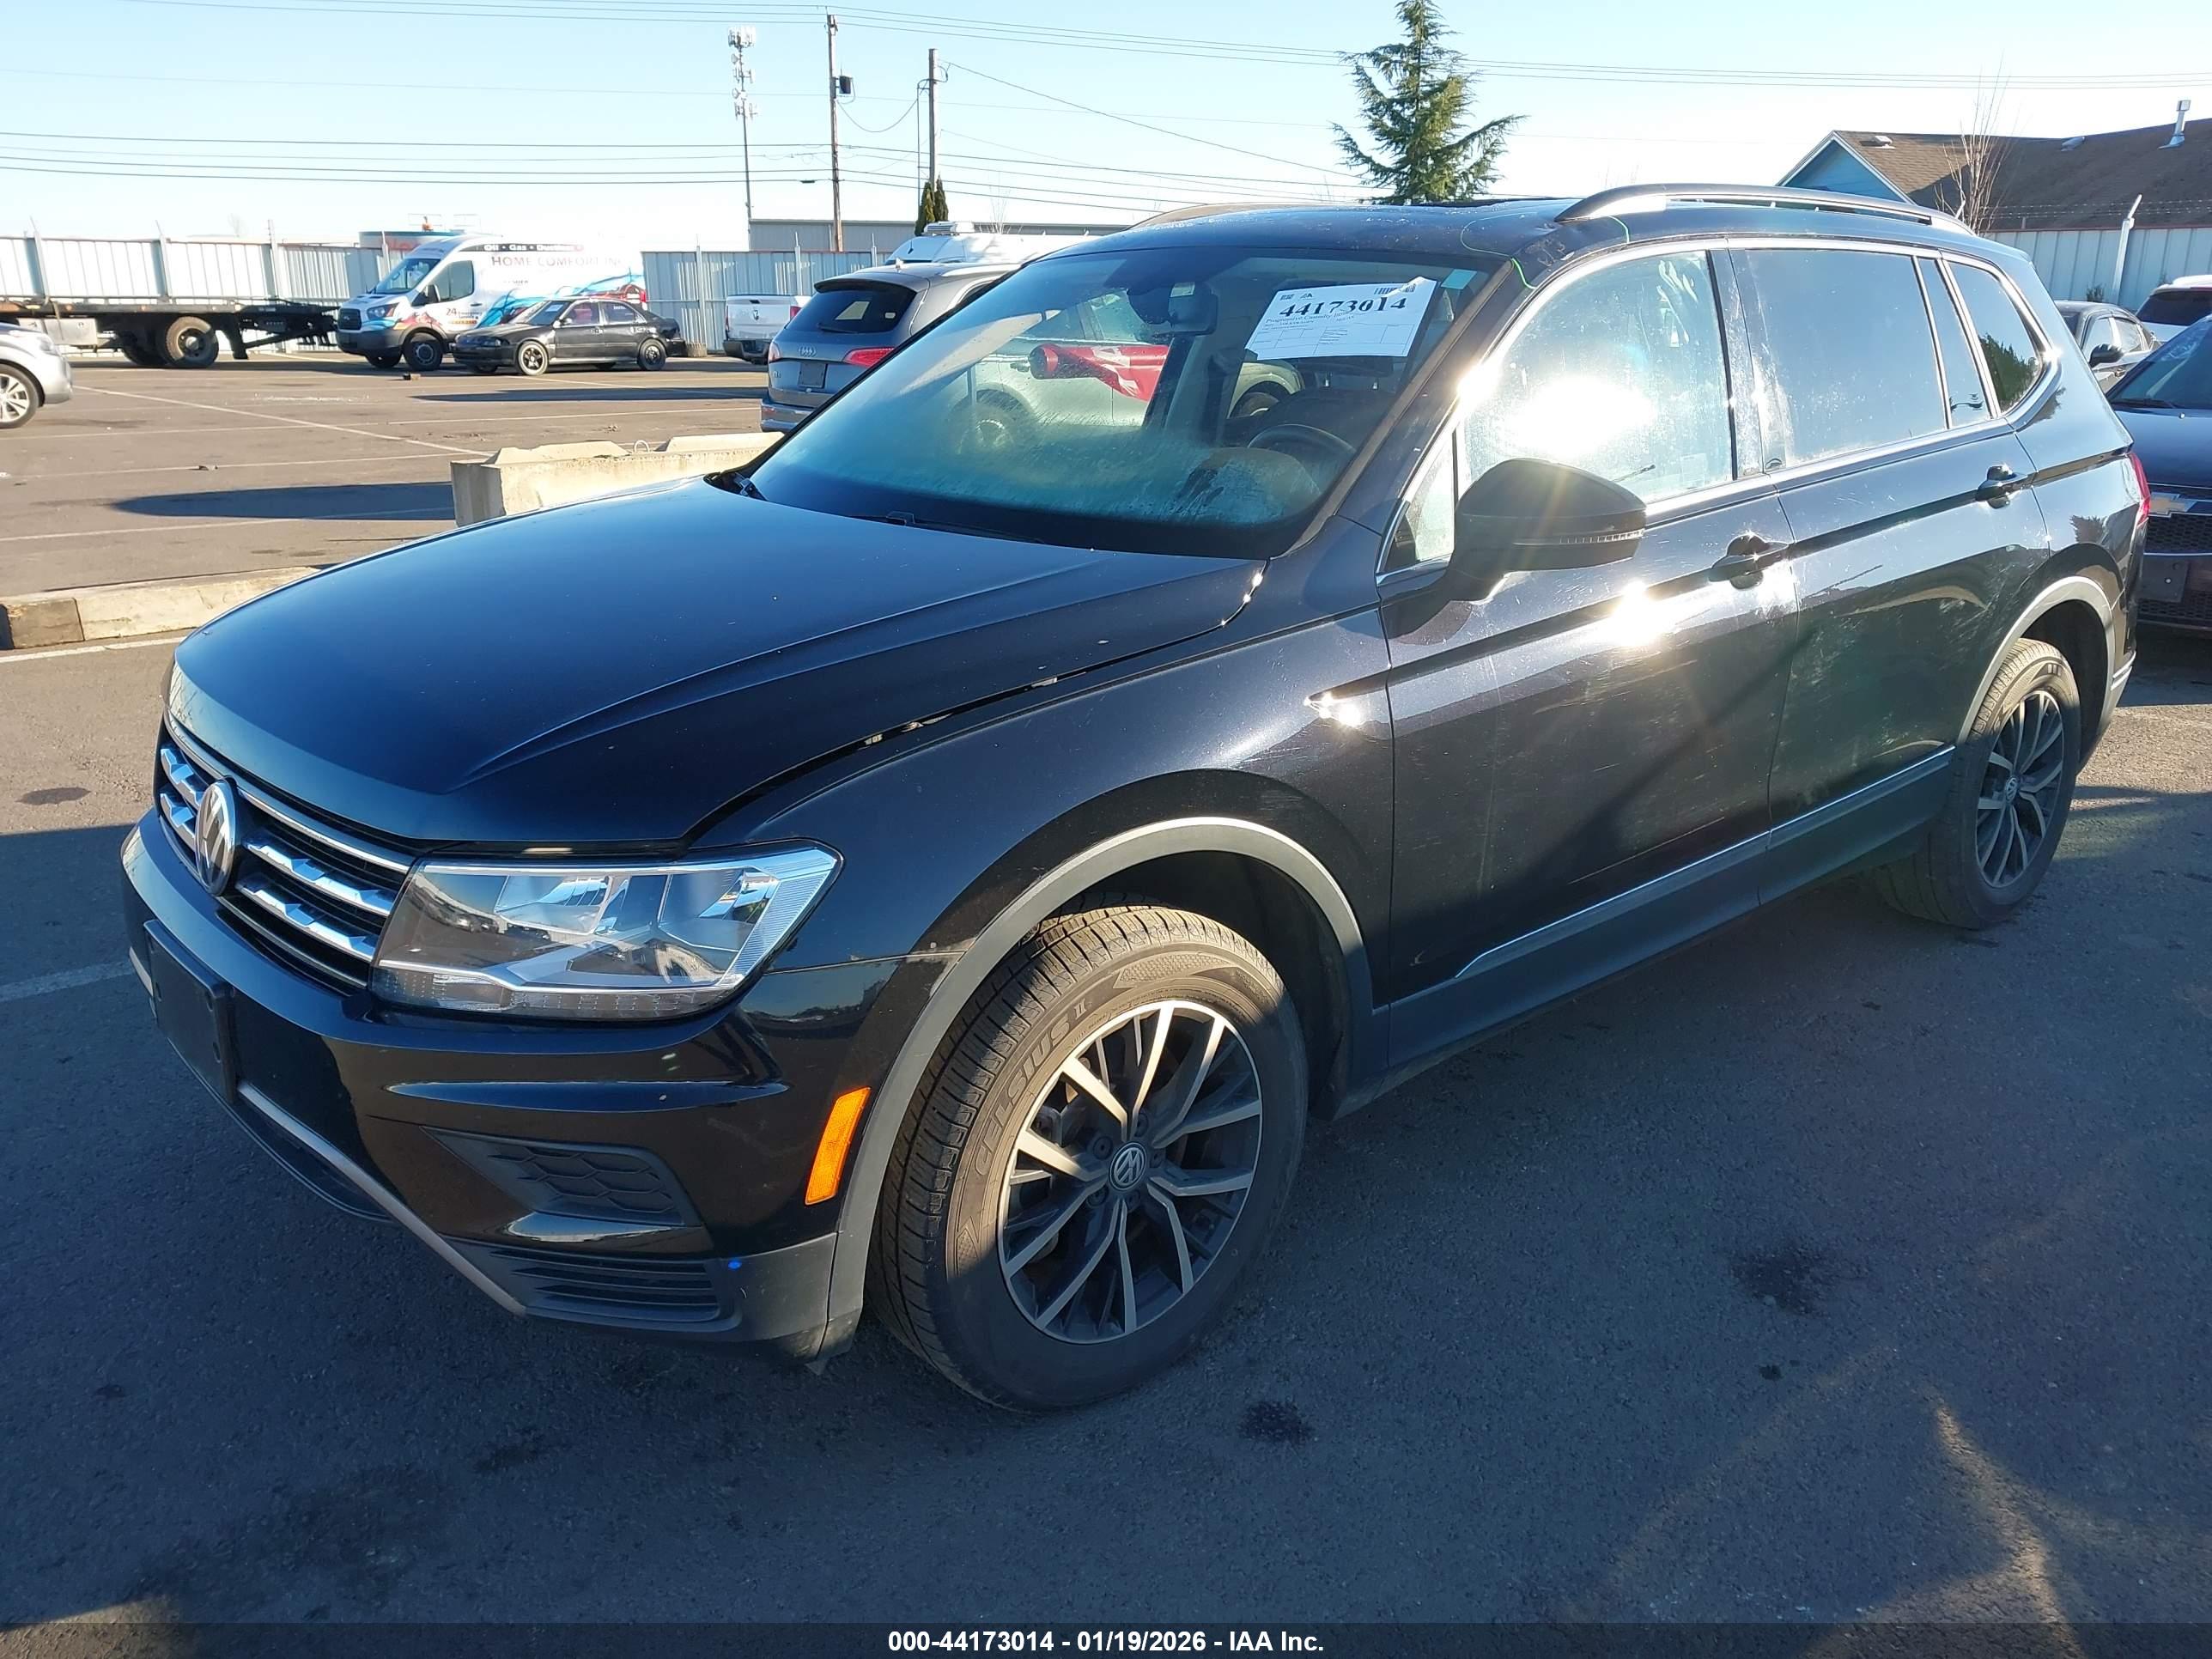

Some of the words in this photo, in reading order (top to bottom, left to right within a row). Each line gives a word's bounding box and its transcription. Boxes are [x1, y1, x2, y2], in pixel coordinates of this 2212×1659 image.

[491, 256, 532, 267] HOME
[538, 256, 600, 267] COMFORT
[1279, 296, 1407, 317] 44173014
[974, 1013, 1072, 1176] CELSIUS
